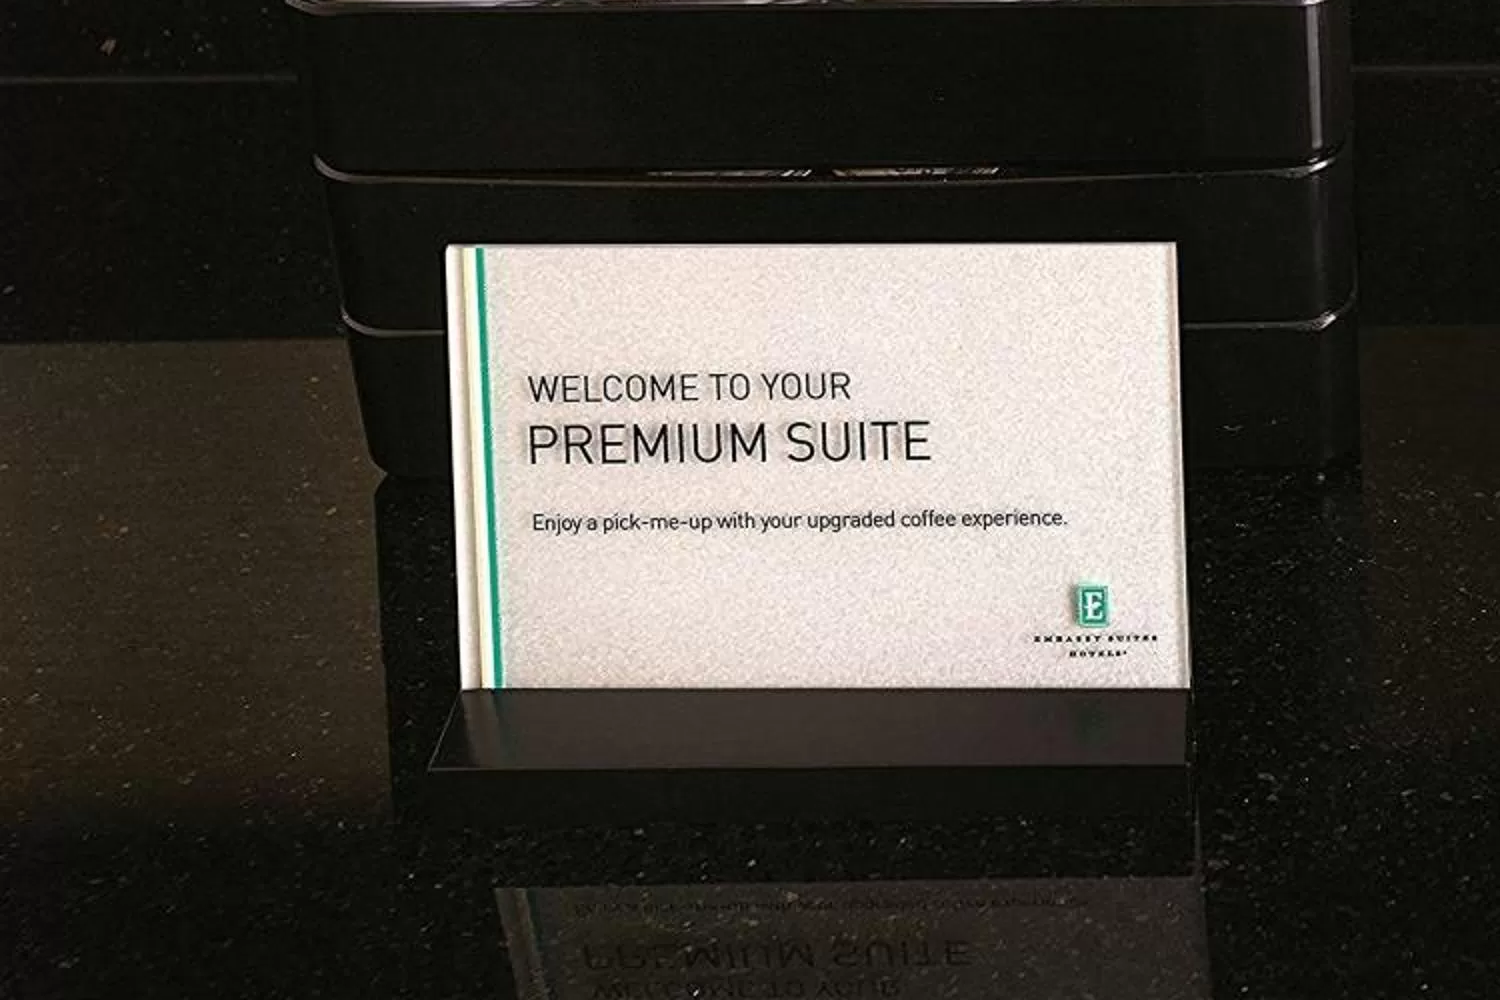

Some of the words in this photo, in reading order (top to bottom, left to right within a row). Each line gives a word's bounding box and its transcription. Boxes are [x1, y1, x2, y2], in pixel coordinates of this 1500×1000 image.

[527, 373, 700, 403] WELCOME
[709, 372, 751, 402] TO
[760, 371, 852, 401] YOUR
[528, 421, 768, 465] PREMIUM
[786, 419, 932, 463] SUITE
[533, 513, 582, 536] Enjoy
[586, 517, 598, 532] a
[602, 512, 713, 535] pick-me-up
[715, 511, 756, 531] with
[760, 516, 801, 534] your
[807, 510, 896, 533] upgraded
[900, 509, 957, 528] coffee
[961, 509, 1068, 531] experience.
